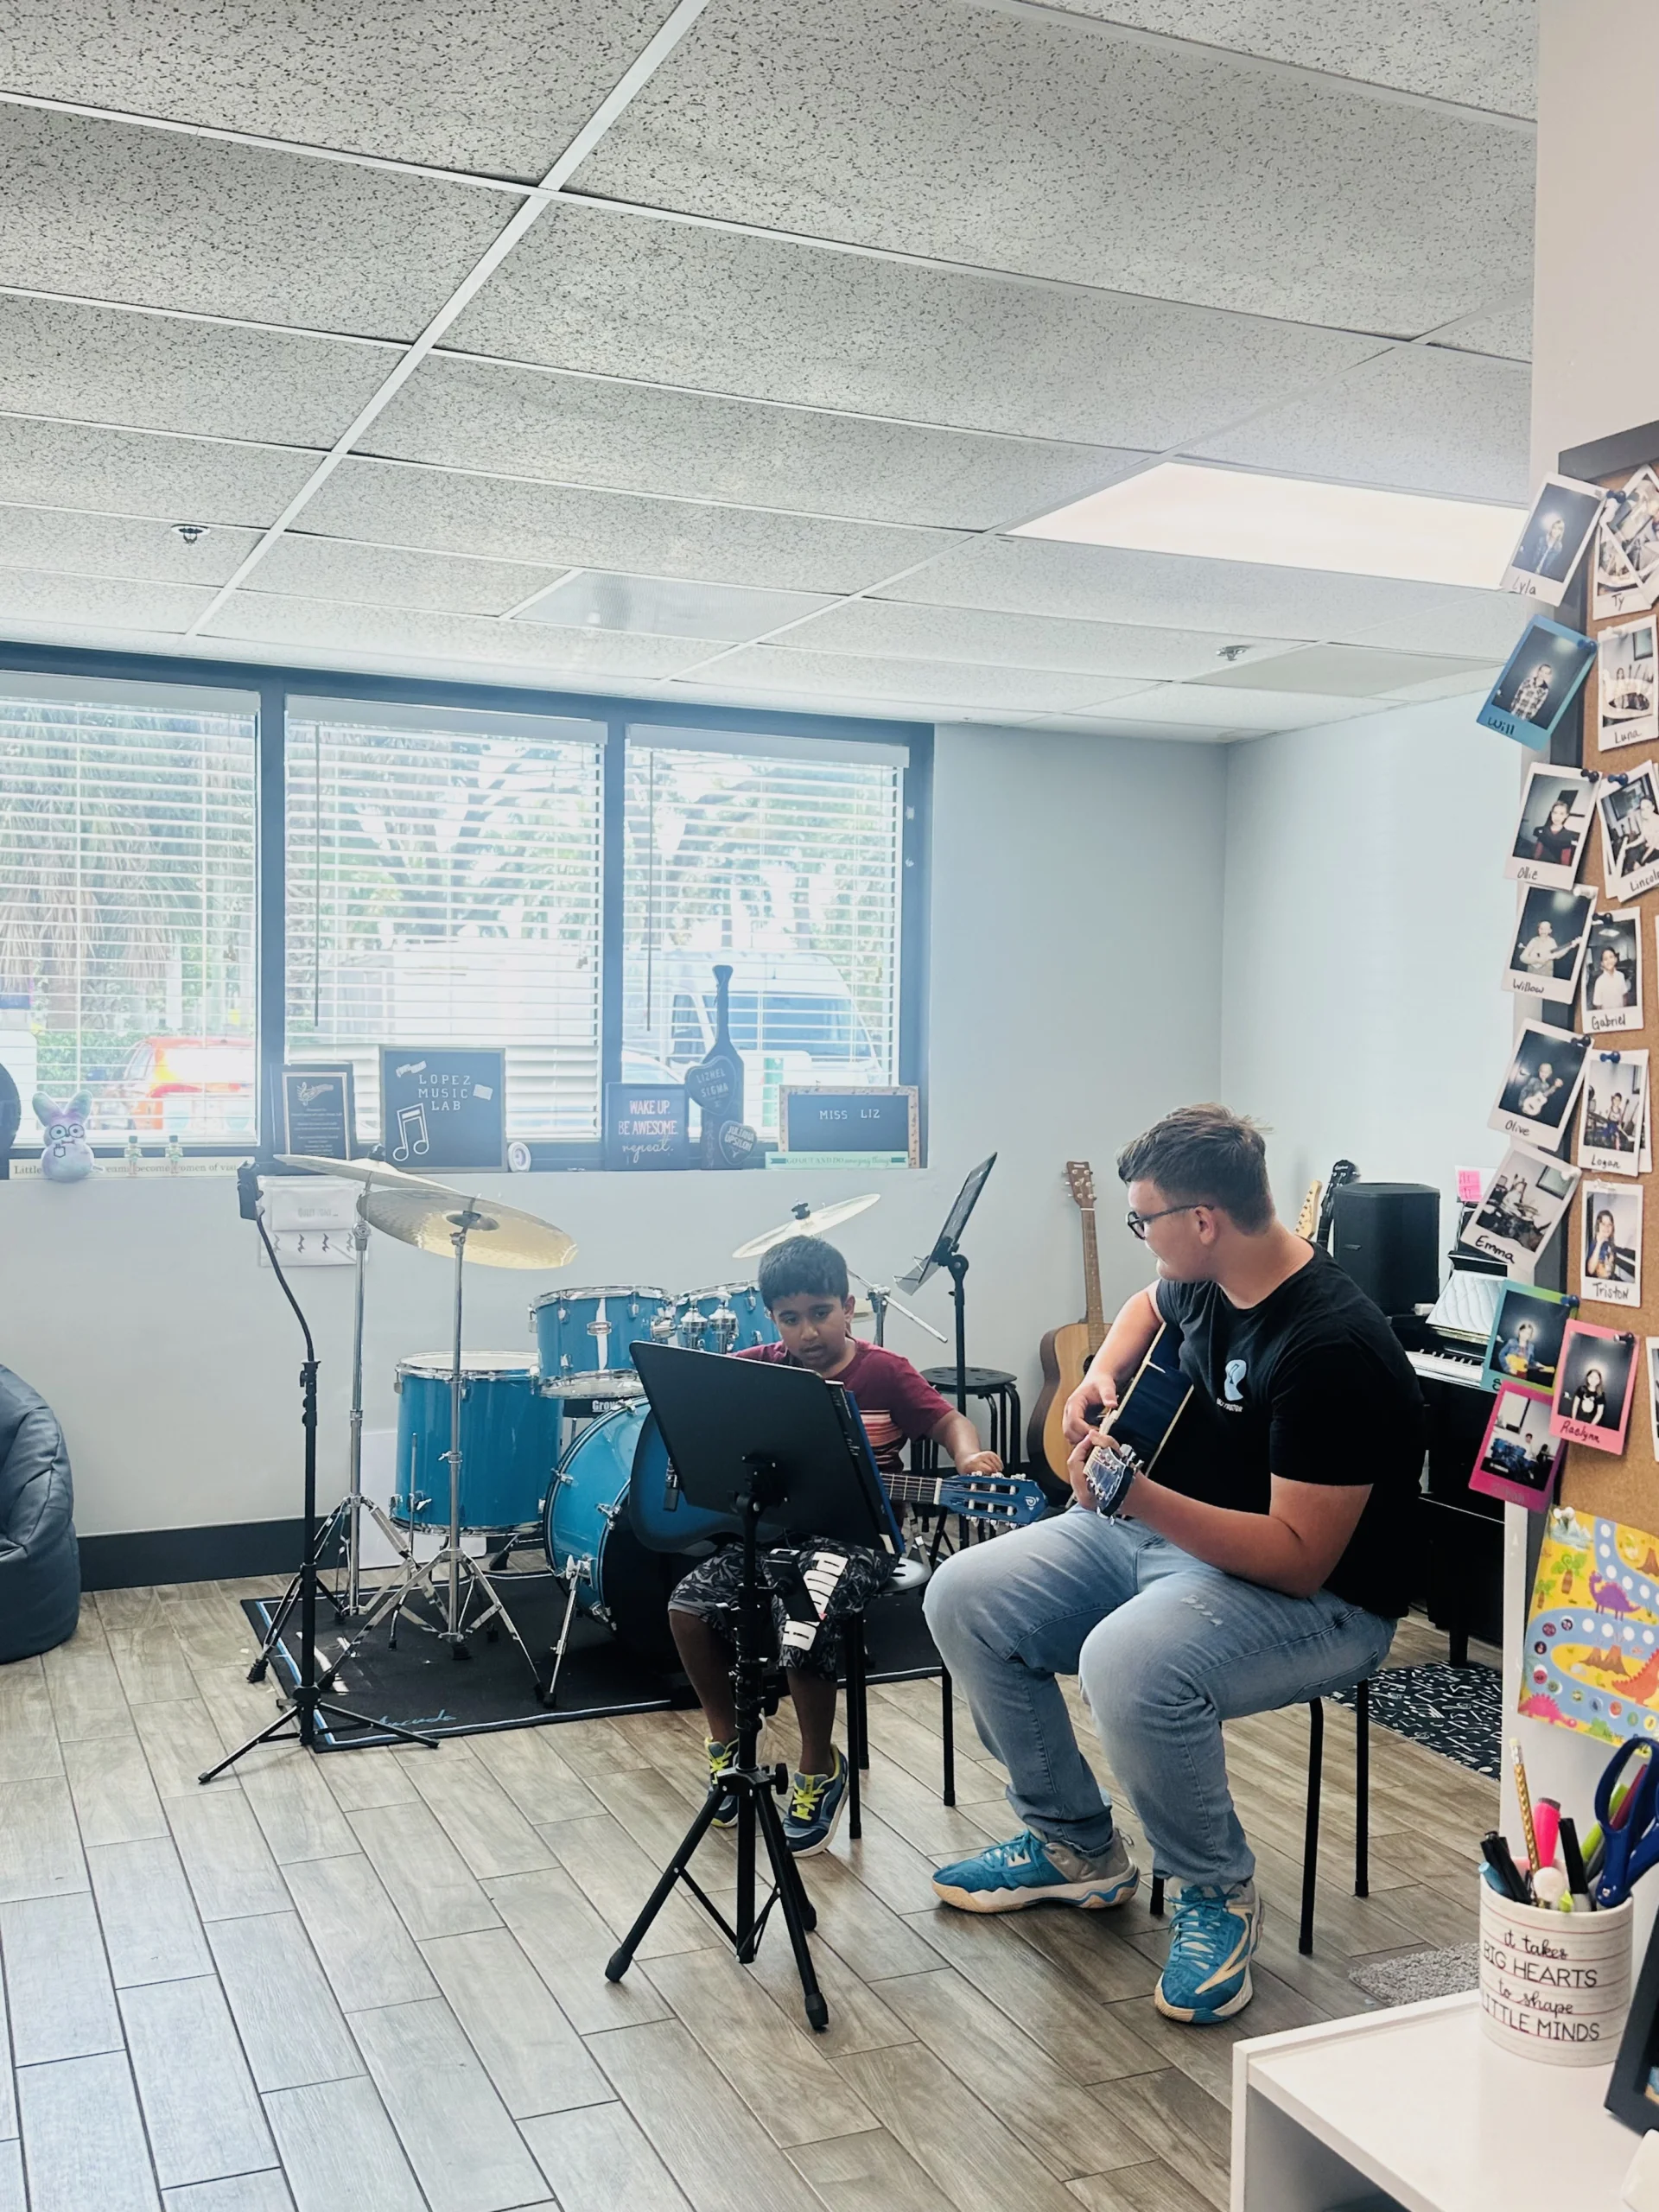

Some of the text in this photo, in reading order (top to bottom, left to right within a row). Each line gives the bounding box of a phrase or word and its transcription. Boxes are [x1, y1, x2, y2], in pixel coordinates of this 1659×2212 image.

[1512, 577, 1536, 595] Lyla
[1611, 593, 1624, 608] Ty
[1487, 716, 1516, 734] Will
[1614, 729, 1642, 745] Luna
[1516, 866, 1538, 881] Ollie
[1591, 1014, 1626, 1031] Gabriel
[419, 1074, 471, 1085] LOPEZ
[418, 1088, 468, 1099] MUSIC
[701, 1082, 729, 1097] SIGMA
[431, 1101, 461, 1111] LAB
[629, 1100, 656, 1115] WAKE
[819, 1109, 880, 1120] MISS LIZ
[618, 1120, 631, 1135] BE
[1504, 1119, 1531, 1137] Olive
[14, 1165, 41, 1174] Little
[208, 1162, 219, 1172] of
[1591, 1154, 1622, 1170] Logan
[1475, 1235, 1516, 1264] Emma
[1503, 1929, 1568, 1960] it takes
[1483, 1940, 1599, 1987] BIG HEARTS
[1497, 1977, 1573, 2019] to shape
[1537, 2019, 1600, 2042] MINDS
